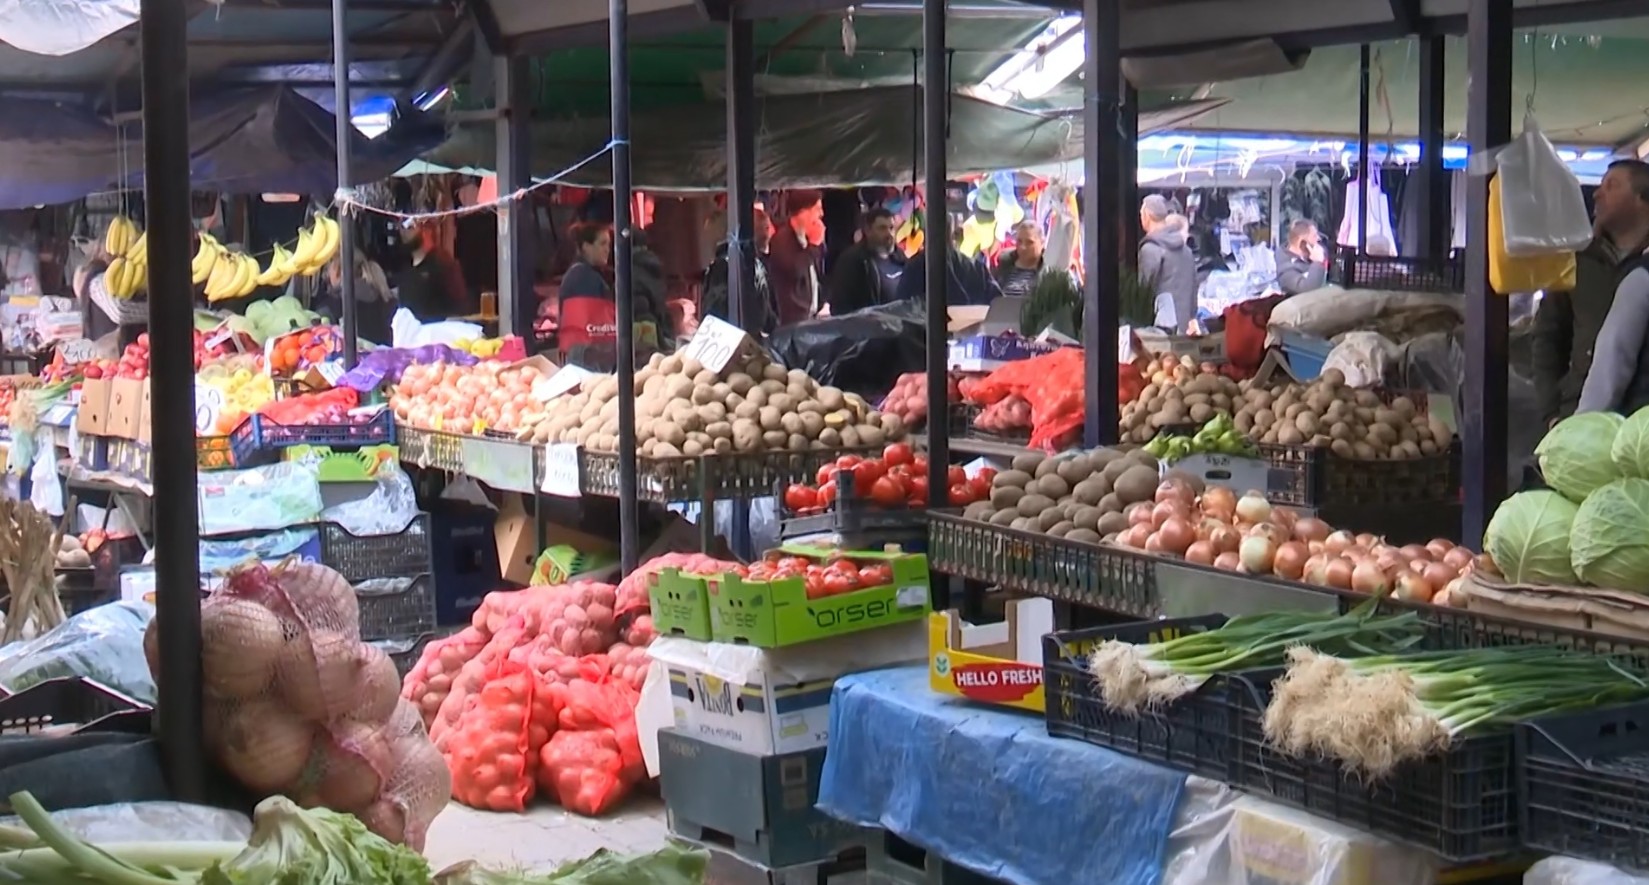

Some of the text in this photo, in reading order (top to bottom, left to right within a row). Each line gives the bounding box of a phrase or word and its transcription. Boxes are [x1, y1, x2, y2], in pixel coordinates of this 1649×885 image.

[693, 337, 732, 370] 100
[816, 598, 894, 628] orser
[956, 668, 1043, 687] HELLO FRESH
